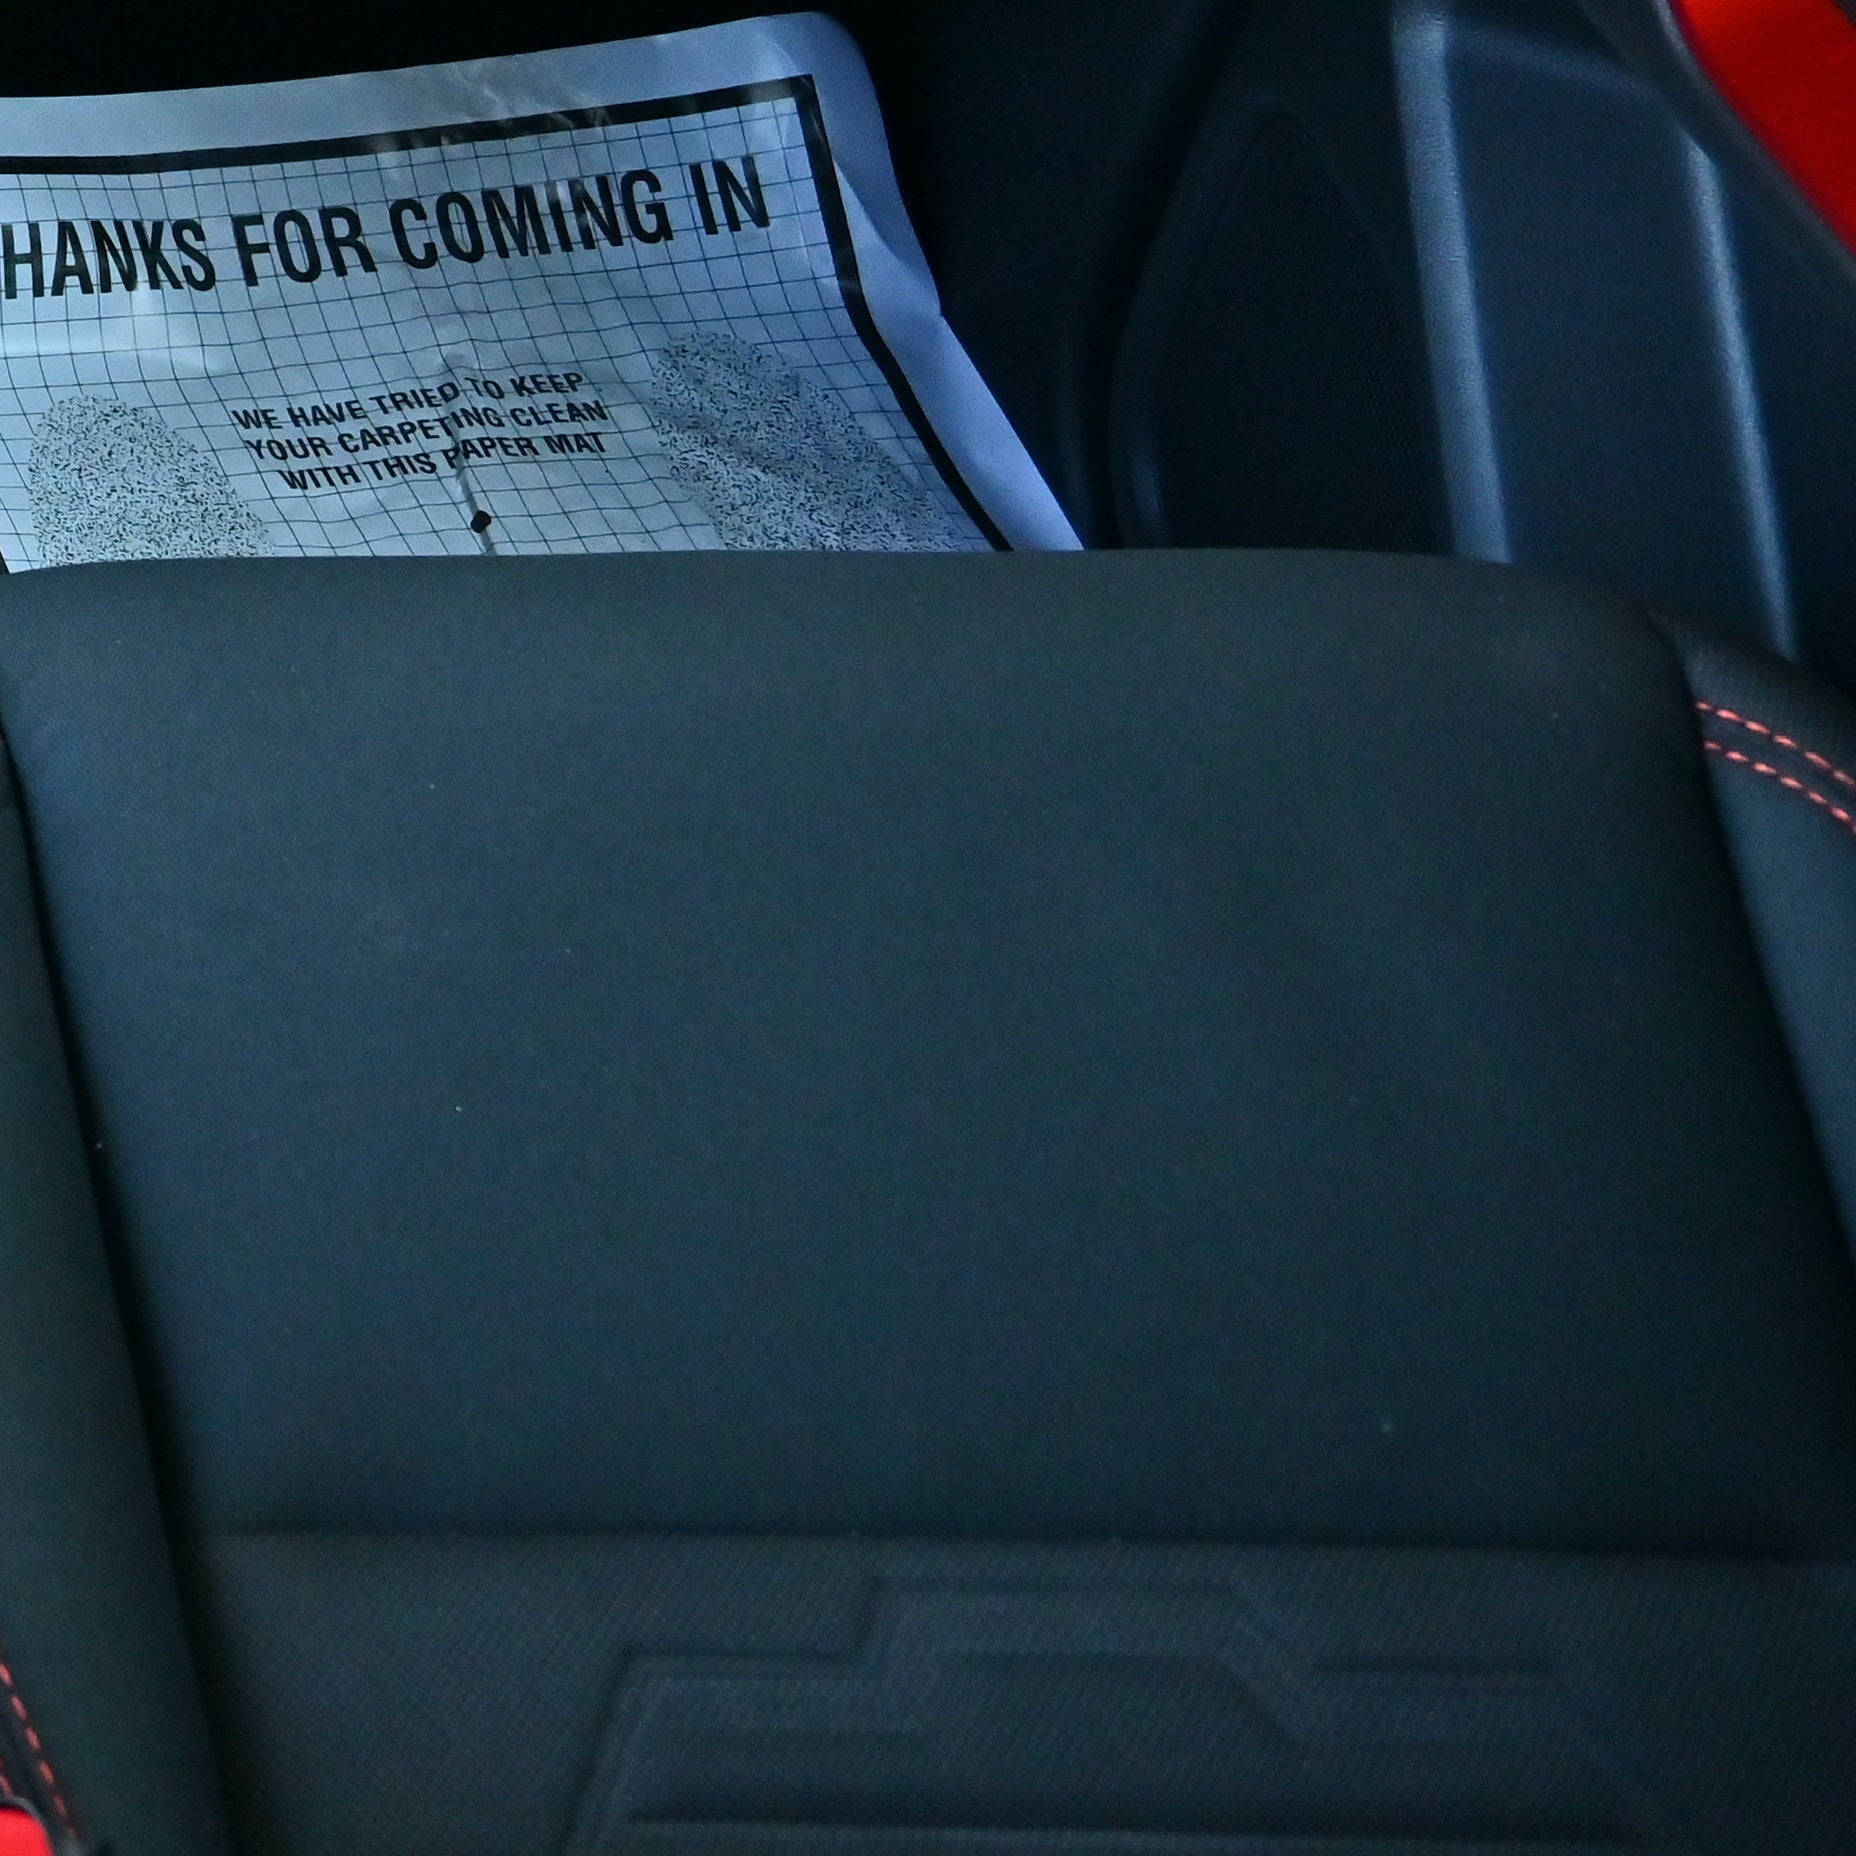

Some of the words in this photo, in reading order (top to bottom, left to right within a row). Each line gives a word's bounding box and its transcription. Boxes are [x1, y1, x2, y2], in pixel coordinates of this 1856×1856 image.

[232, 205, 378, 287] FOR
[389, 169, 673, 269] COMING
[689, 155, 770, 235] IN
[232, 408, 280, 431] WE
[287, 400, 368, 427] HAVE
[370, 382, 459, 414] TRIED
[465, 377, 504, 399] TO
[509, 372, 585, 397] KEEP
[245, 438, 331, 461] YOUR
[337, 405, 504, 453] CARPETING
[509, 400, 609, 427] CLEAN
[279, 465, 361, 491] WITH
[364, 454, 436, 481] THIS
[445, 437, 540, 468] PAPER
[544, 432, 607, 454] MAT
